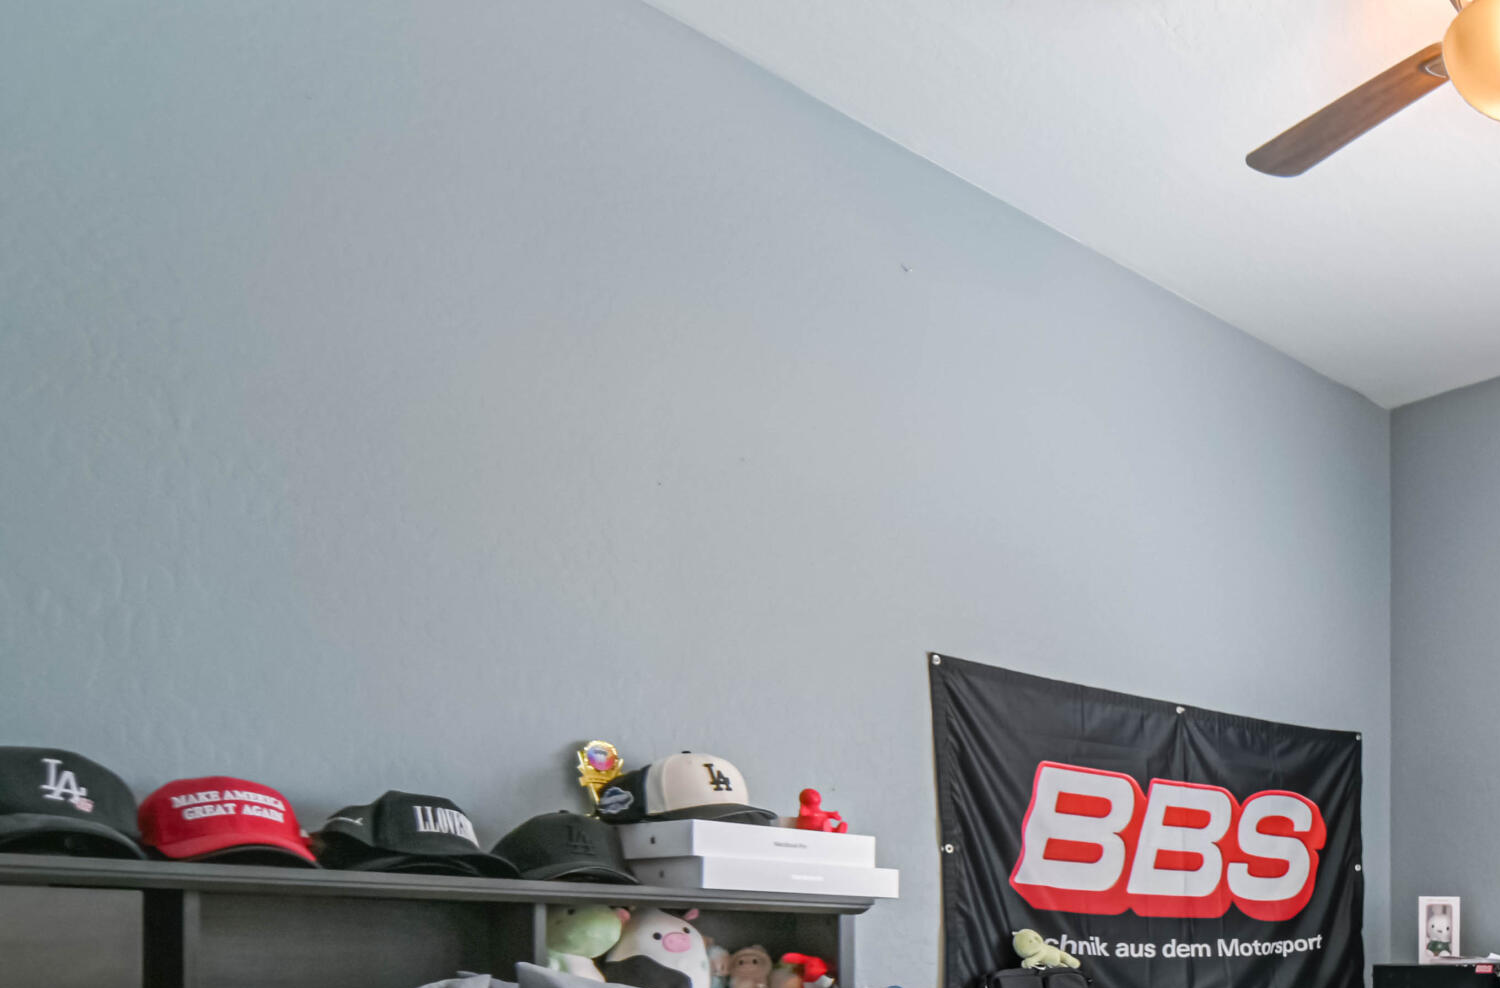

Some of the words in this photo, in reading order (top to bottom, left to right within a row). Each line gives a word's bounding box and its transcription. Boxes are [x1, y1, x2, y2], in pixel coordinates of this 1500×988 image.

[39, 758, 88, 804] LA
[703, 764, 732, 791] LA
[171, 791, 220, 808] MAKE
[223, 790, 286, 811] AMERICA
[182, 803, 236, 820] GREAT
[241, 804, 285, 823] AGAIN
[1010, 761, 1326, 921] BBS
[1115, 942, 1156, 958] aus
[1162, 939, 1212, 958] dem
[1217, 934, 1322, 957] Motorsport
